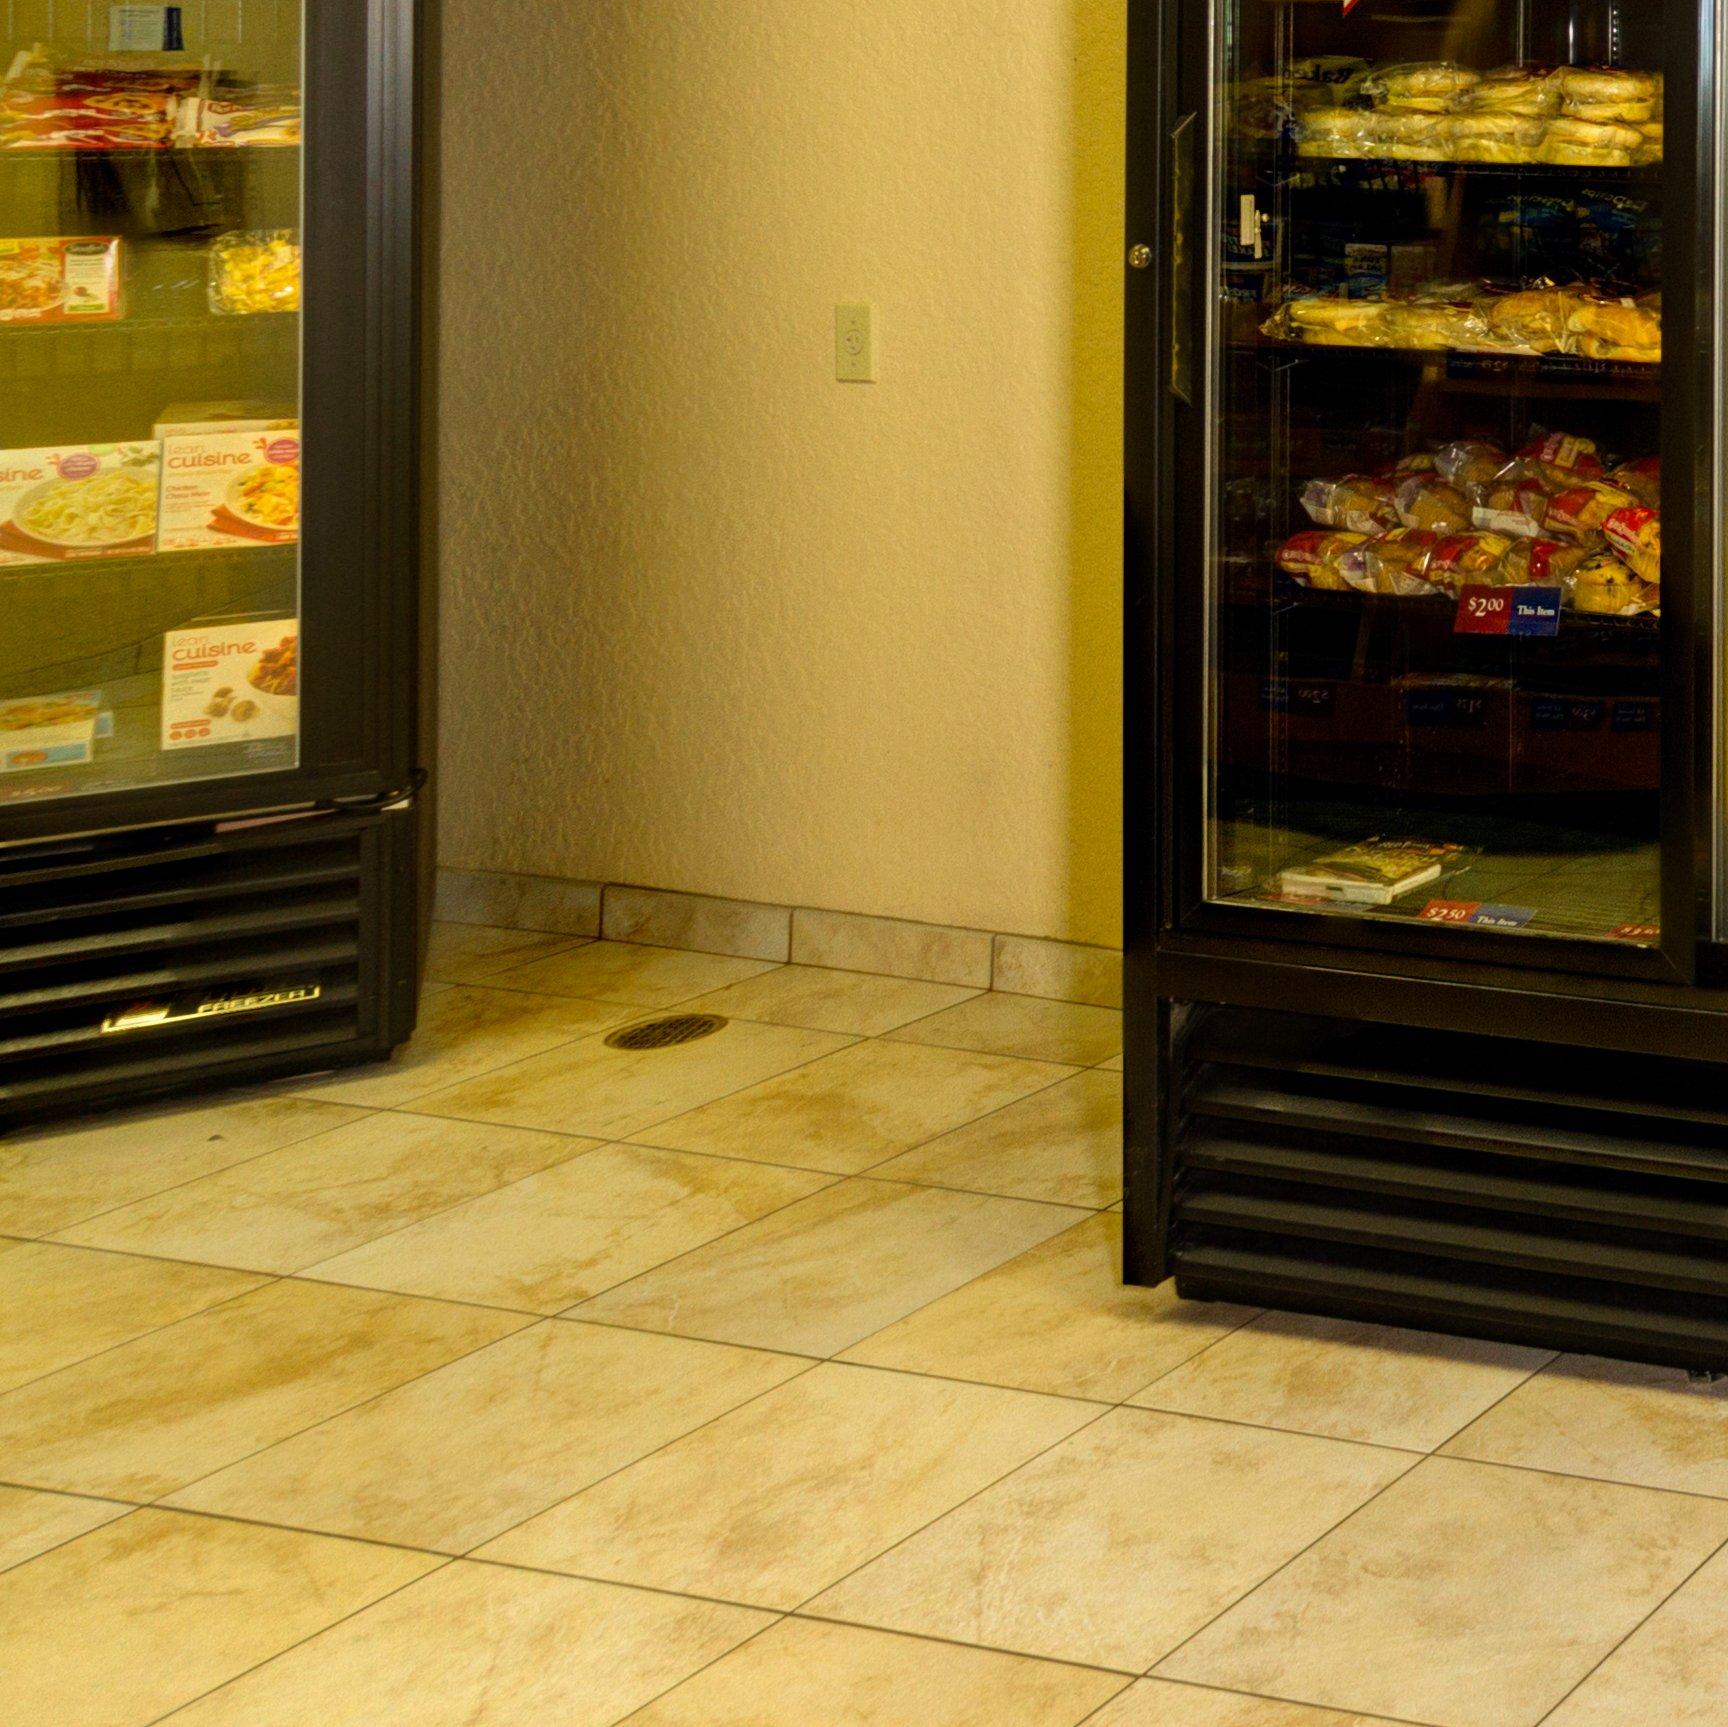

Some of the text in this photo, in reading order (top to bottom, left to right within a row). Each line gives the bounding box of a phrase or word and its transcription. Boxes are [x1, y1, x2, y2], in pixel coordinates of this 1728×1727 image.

[168, 452, 252, 469] cuisine
[1517, 604, 1535, 616] This
[1536, 605, 1555, 617] Item
[172, 641, 256, 661] cuisine
